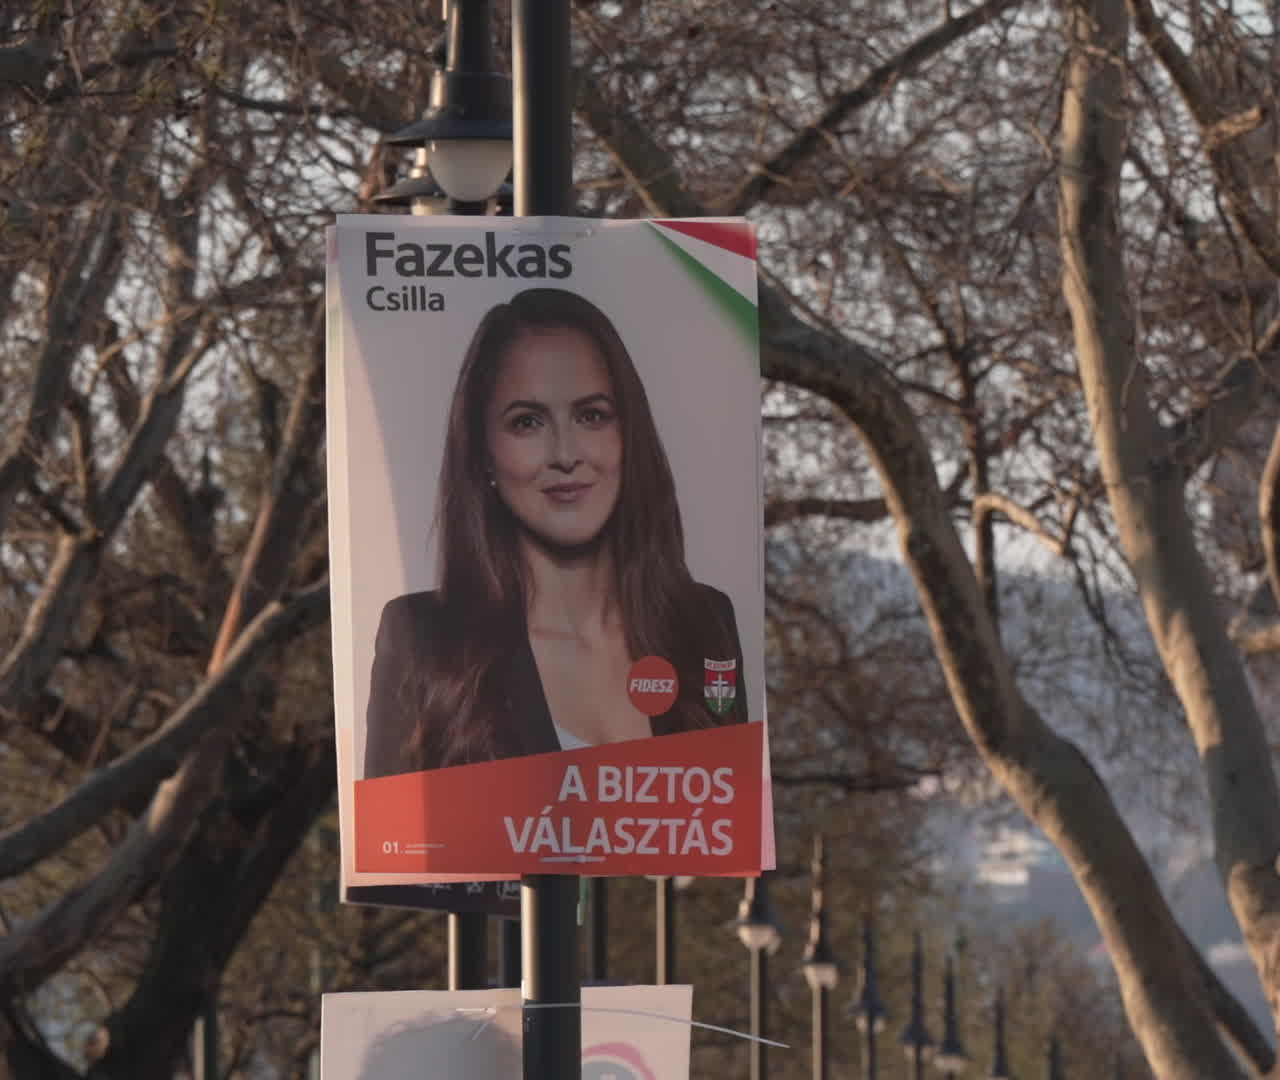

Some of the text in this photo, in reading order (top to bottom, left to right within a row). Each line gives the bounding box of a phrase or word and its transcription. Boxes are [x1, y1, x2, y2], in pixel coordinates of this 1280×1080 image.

[365, 232, 572, 278] Fazekas
[366, 286, 445, 311] Csilla
[630, 679, 674, 693] FIDESZ
[559, 765, 735, 804] A BIZTOS
[504, 806, 734, 855] VÁLASZTÁS
